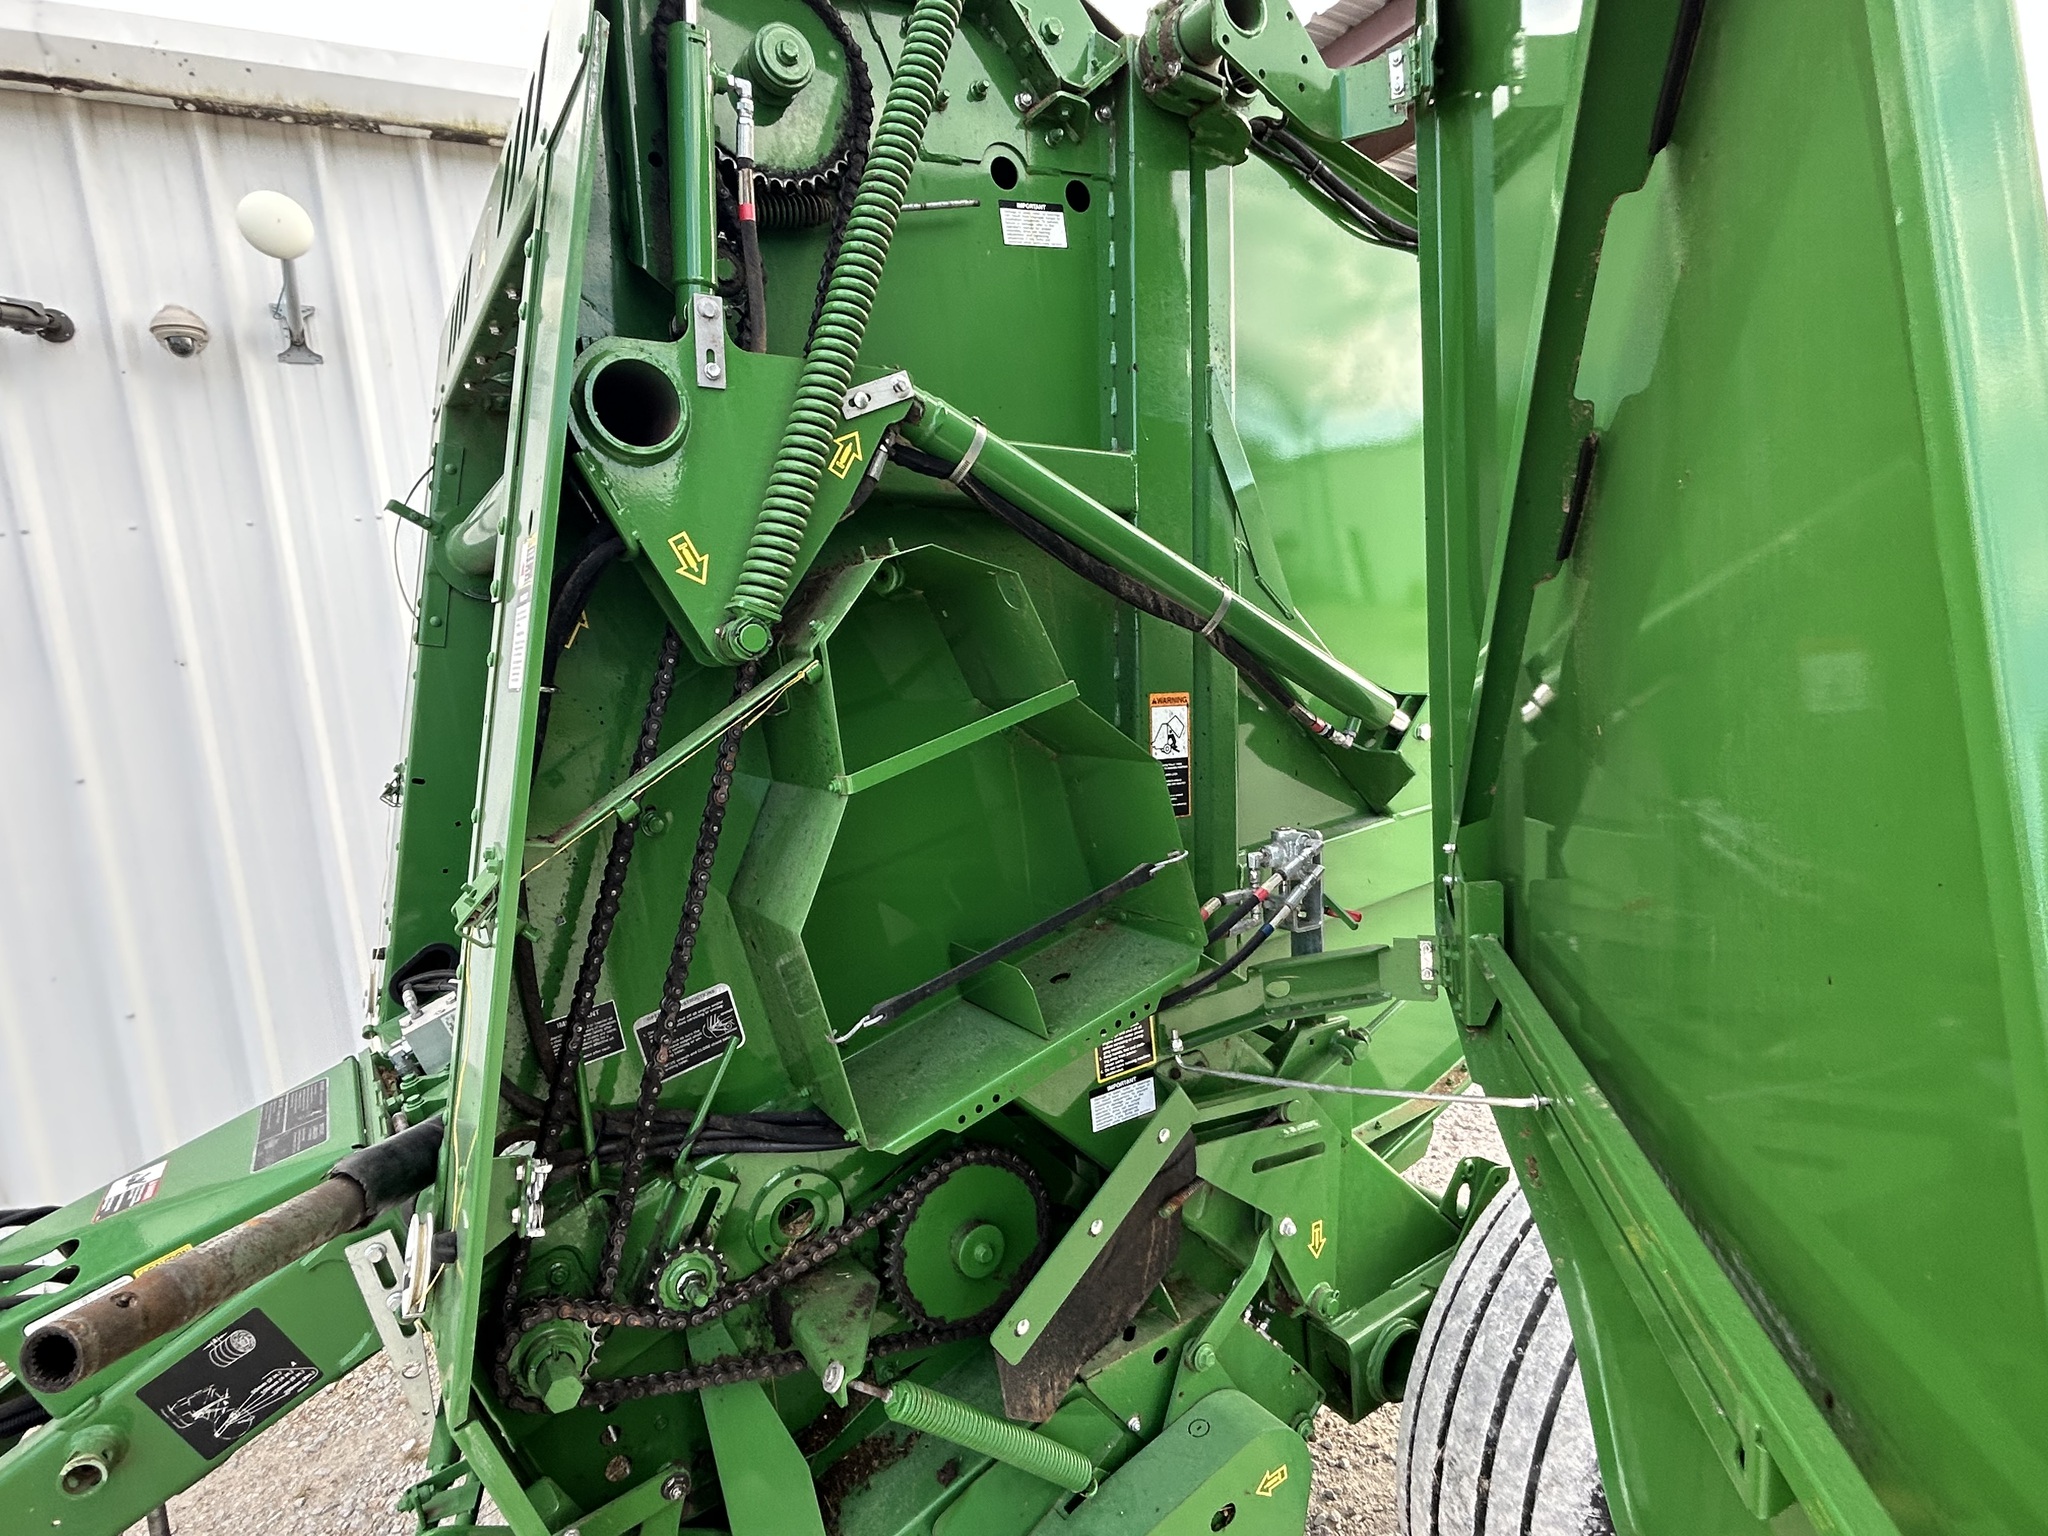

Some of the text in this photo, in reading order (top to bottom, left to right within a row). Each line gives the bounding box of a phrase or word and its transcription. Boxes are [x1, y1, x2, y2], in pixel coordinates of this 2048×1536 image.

[1016, 202, 1047, 210] IMPORTANT
[1157, 696, 1188, 704] WARNING
[1107, 1076, 1136, 1091] IMPORTANT
